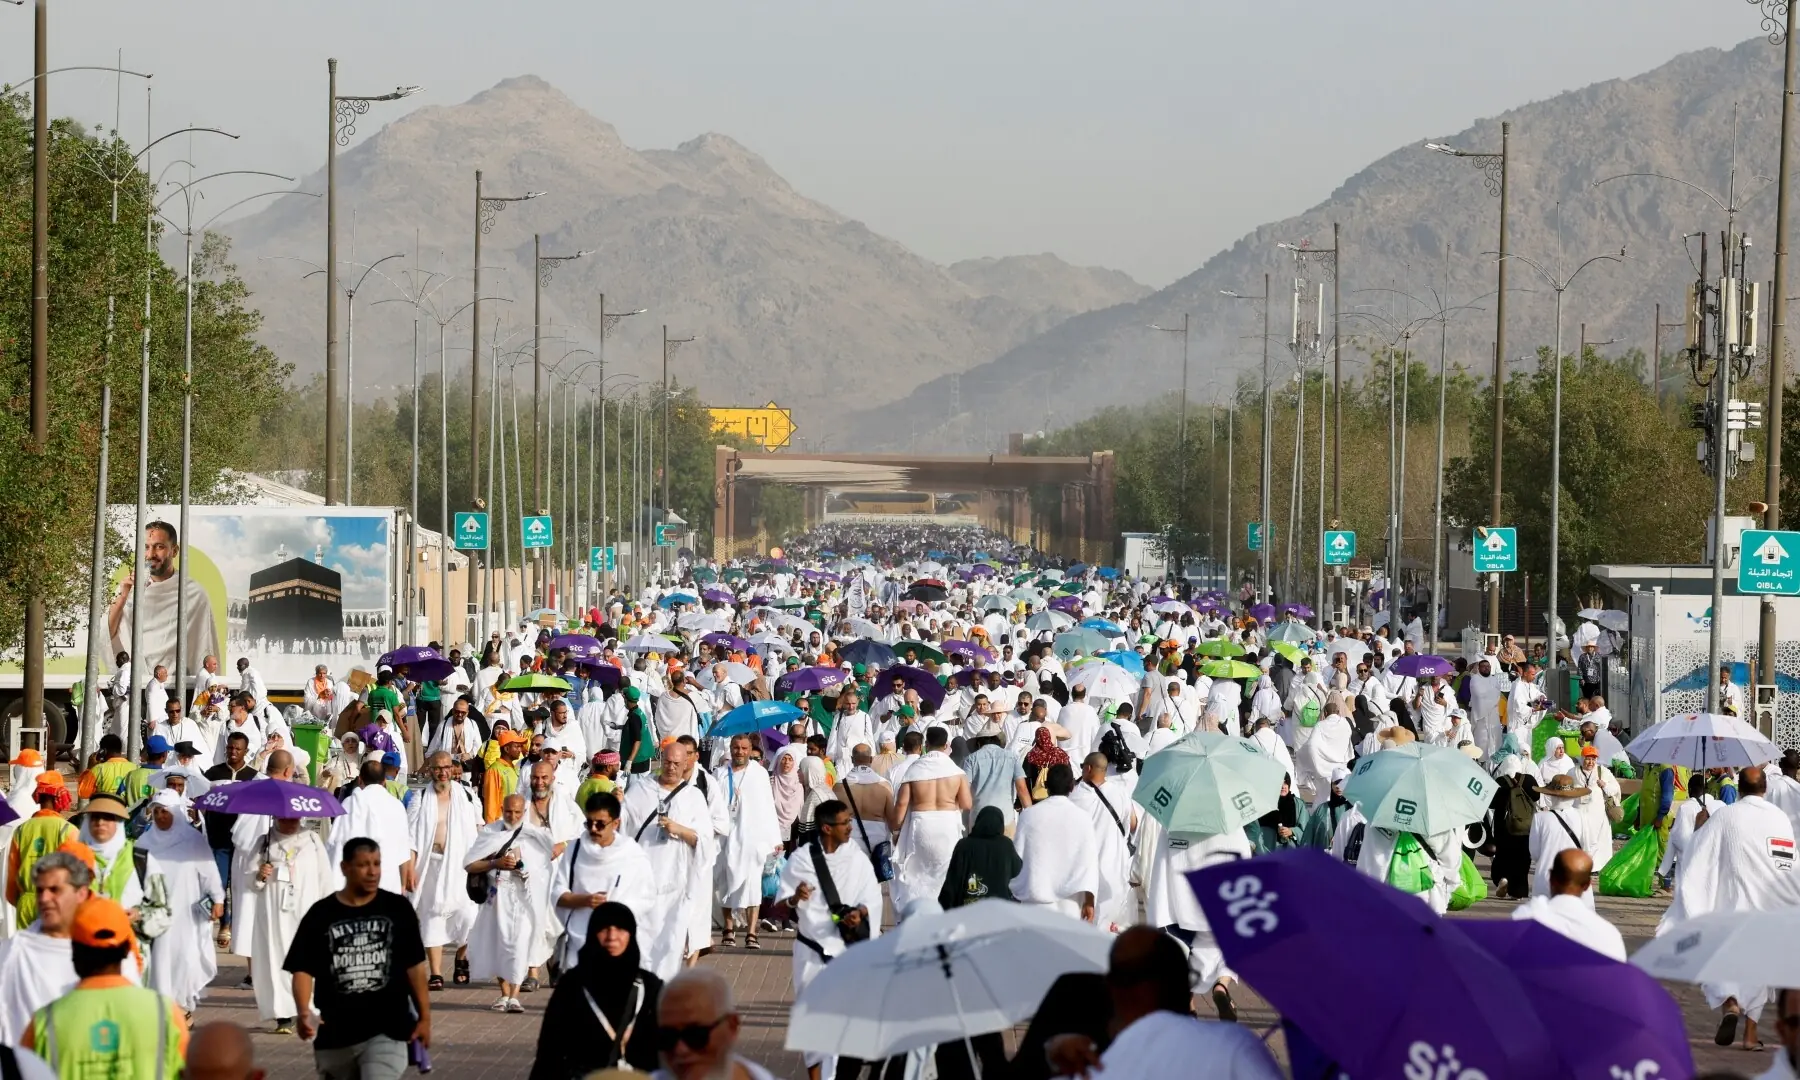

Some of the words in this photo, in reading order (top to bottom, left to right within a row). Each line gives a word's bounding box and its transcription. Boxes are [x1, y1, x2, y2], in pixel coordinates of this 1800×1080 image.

[1480, 554, 1496, 562] القبلة
[1350, 570, 1359, 578] 25
[1748, 567, 1771, 578] القبلة
[1771, 568, 1793, 580] إتجاه
[1756, 582, 1783, 590] QIBLA
[717, 638, 731, 646] stc
[418, 650, 433, 658] stc
[959, 647, 974, 657] stc
[1419, 666, 1436, 675] stc
[821, 675, 837, 685] stc
[203, 791, 229, 807] stc
[290, 796, 322, 812] stc
[1219, 874, 1279, 938] stc
[333, 949, 388, 969] BOURBON
